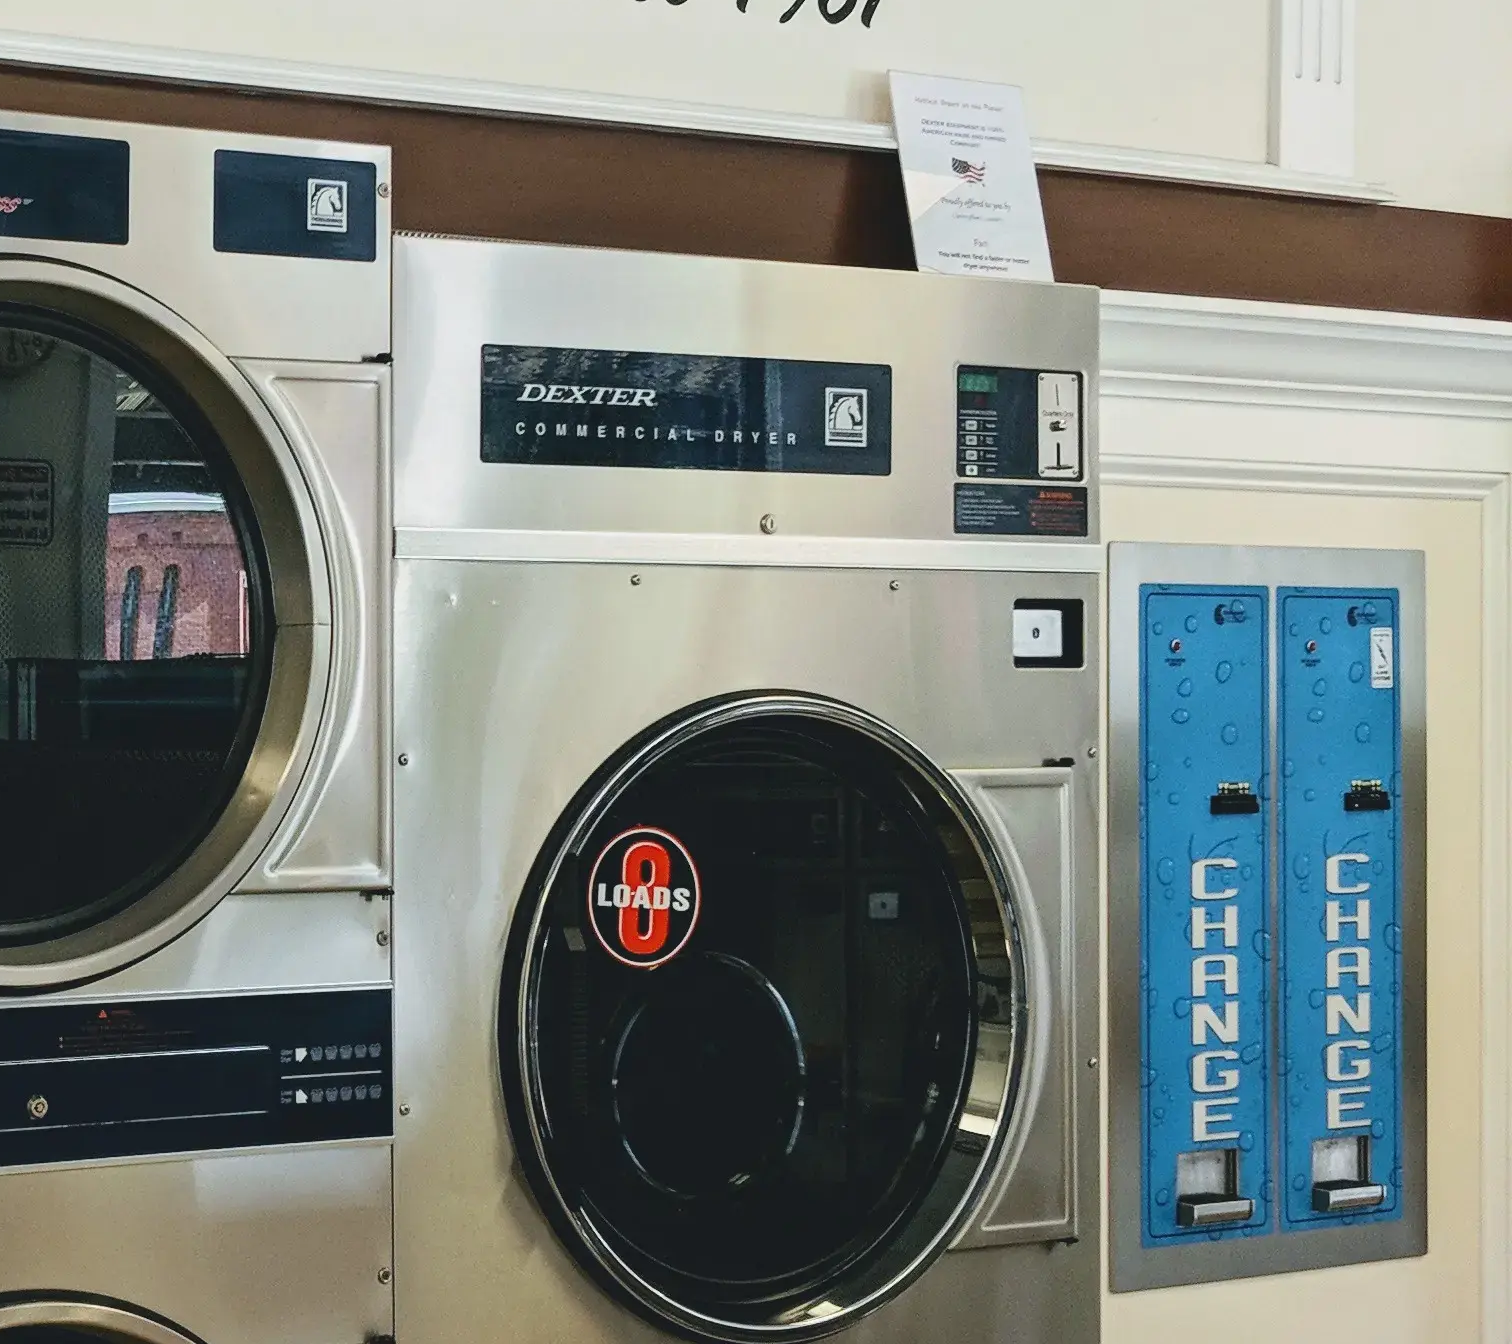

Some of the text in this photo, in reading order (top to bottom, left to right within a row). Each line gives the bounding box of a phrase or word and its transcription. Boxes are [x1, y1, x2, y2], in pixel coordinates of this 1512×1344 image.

[516, 383, 657, 407] DEXTER
[515, 421, 798, 446] COMMERCIAL DRYER
[596, 882, 691, 912] LOADS
[1190, 857, 1240, 1144] CHANGE
[1324, 852, 1372, 1131] CHANGE
